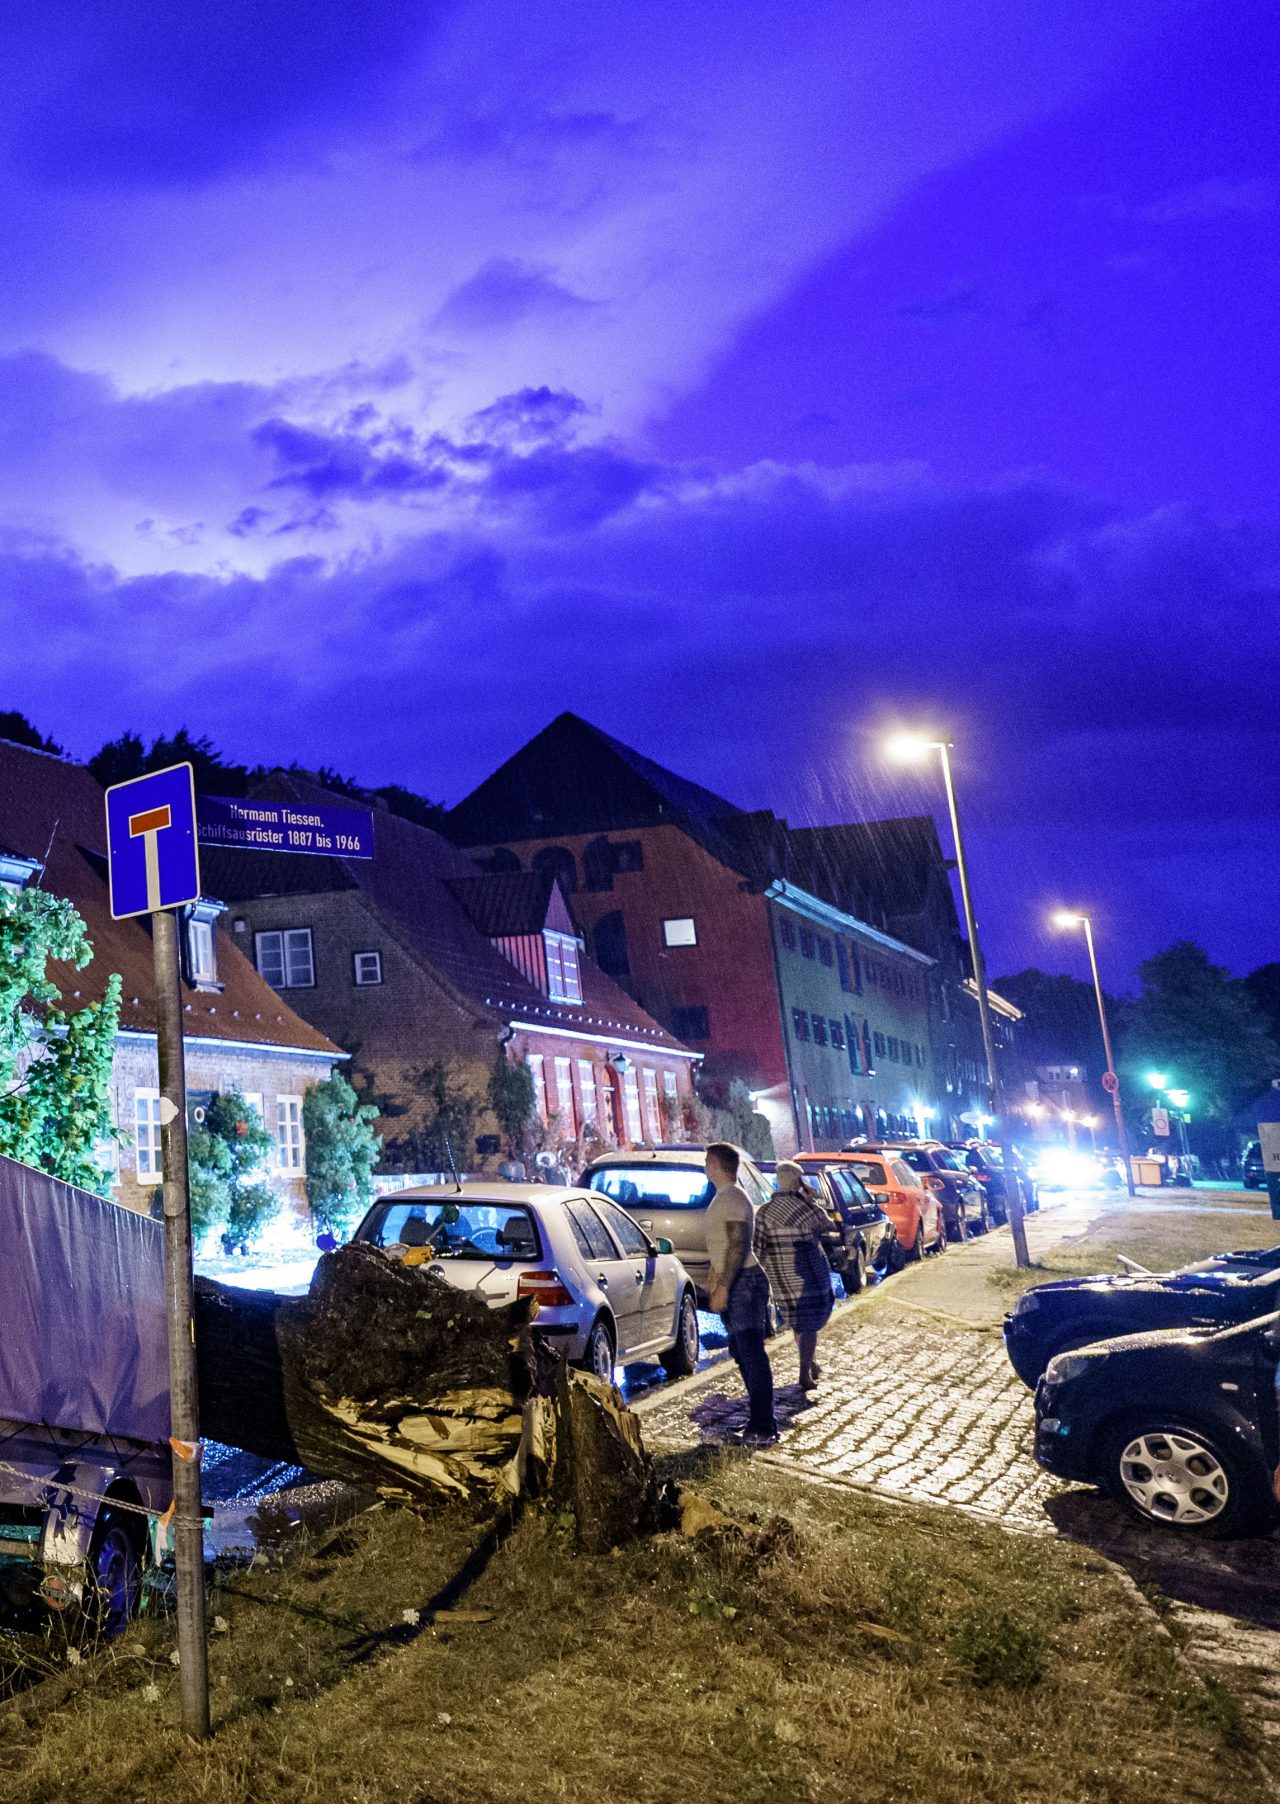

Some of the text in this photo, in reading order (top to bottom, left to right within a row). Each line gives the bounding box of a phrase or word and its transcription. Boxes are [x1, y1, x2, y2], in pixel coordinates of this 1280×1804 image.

[230, 804, 278, 823] Hermann
[288, 830, 312, 846] 1887
[316, 833, 332, 849] bis
[335, 835, 360, 851] 1966
